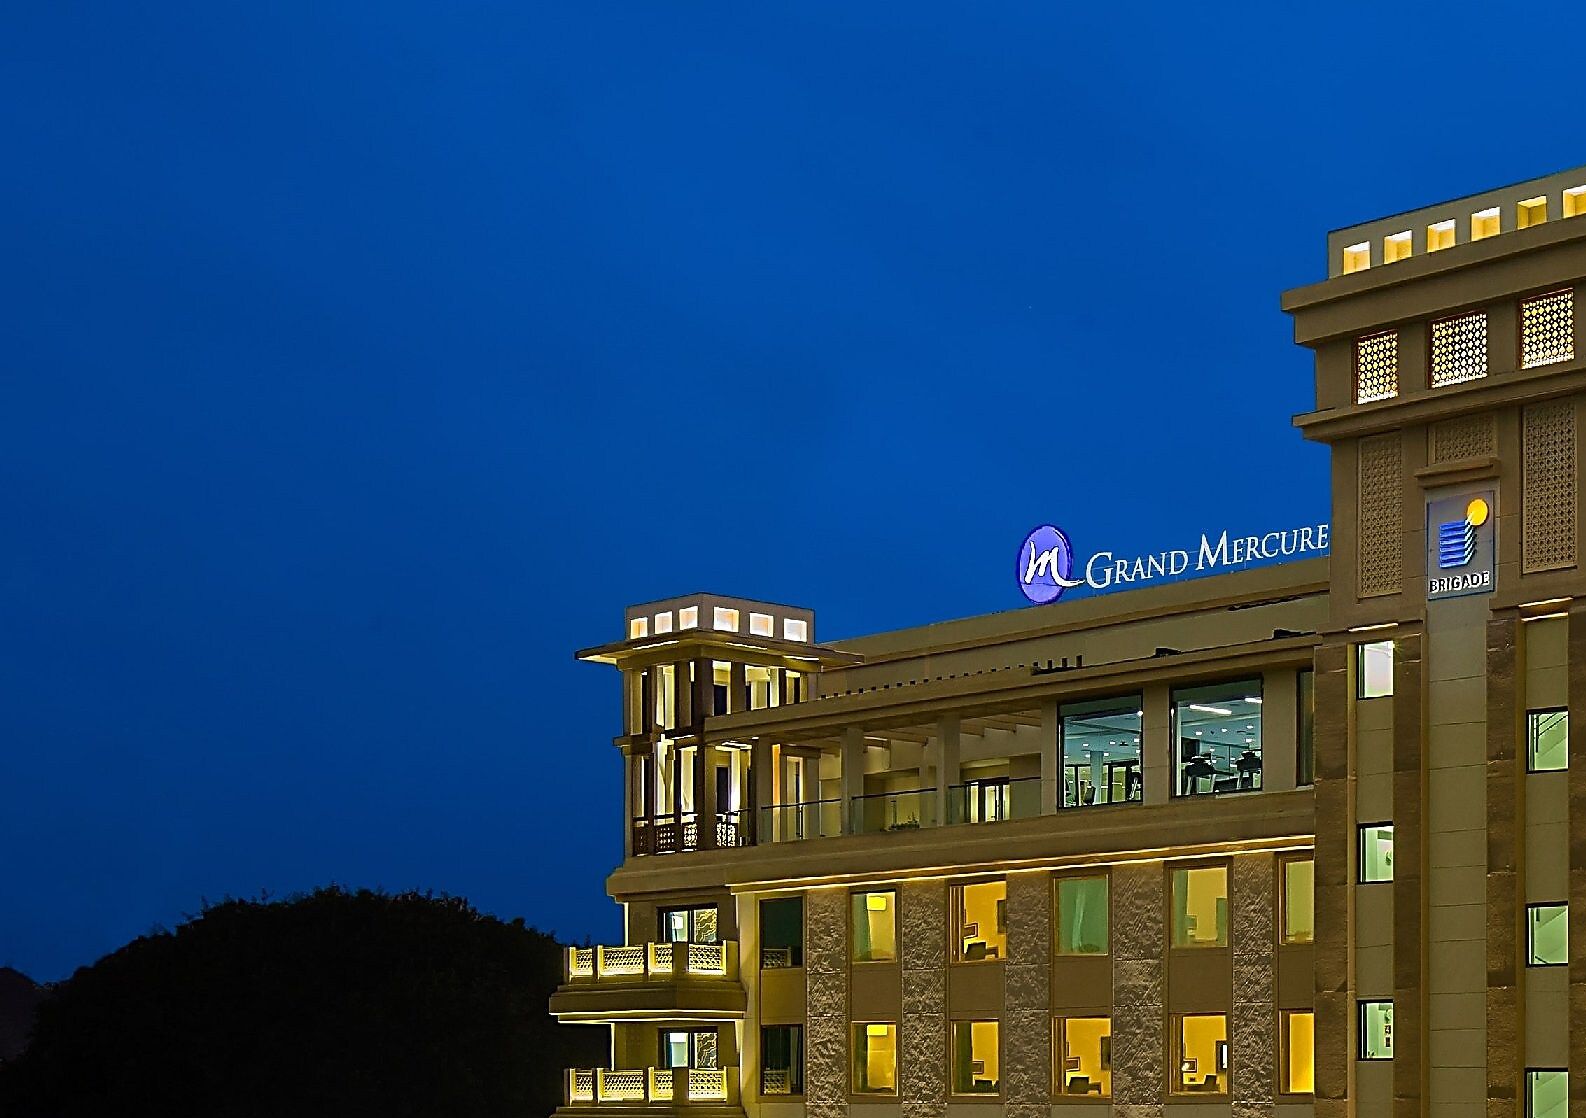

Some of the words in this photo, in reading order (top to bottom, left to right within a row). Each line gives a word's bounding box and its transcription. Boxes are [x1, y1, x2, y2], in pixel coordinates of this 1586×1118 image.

[1085, 551, 1189, 590] GRAND
[1195, 523, 1330, 571] MERCURE
[1428, 570, 1491, 593] BRIGADE
